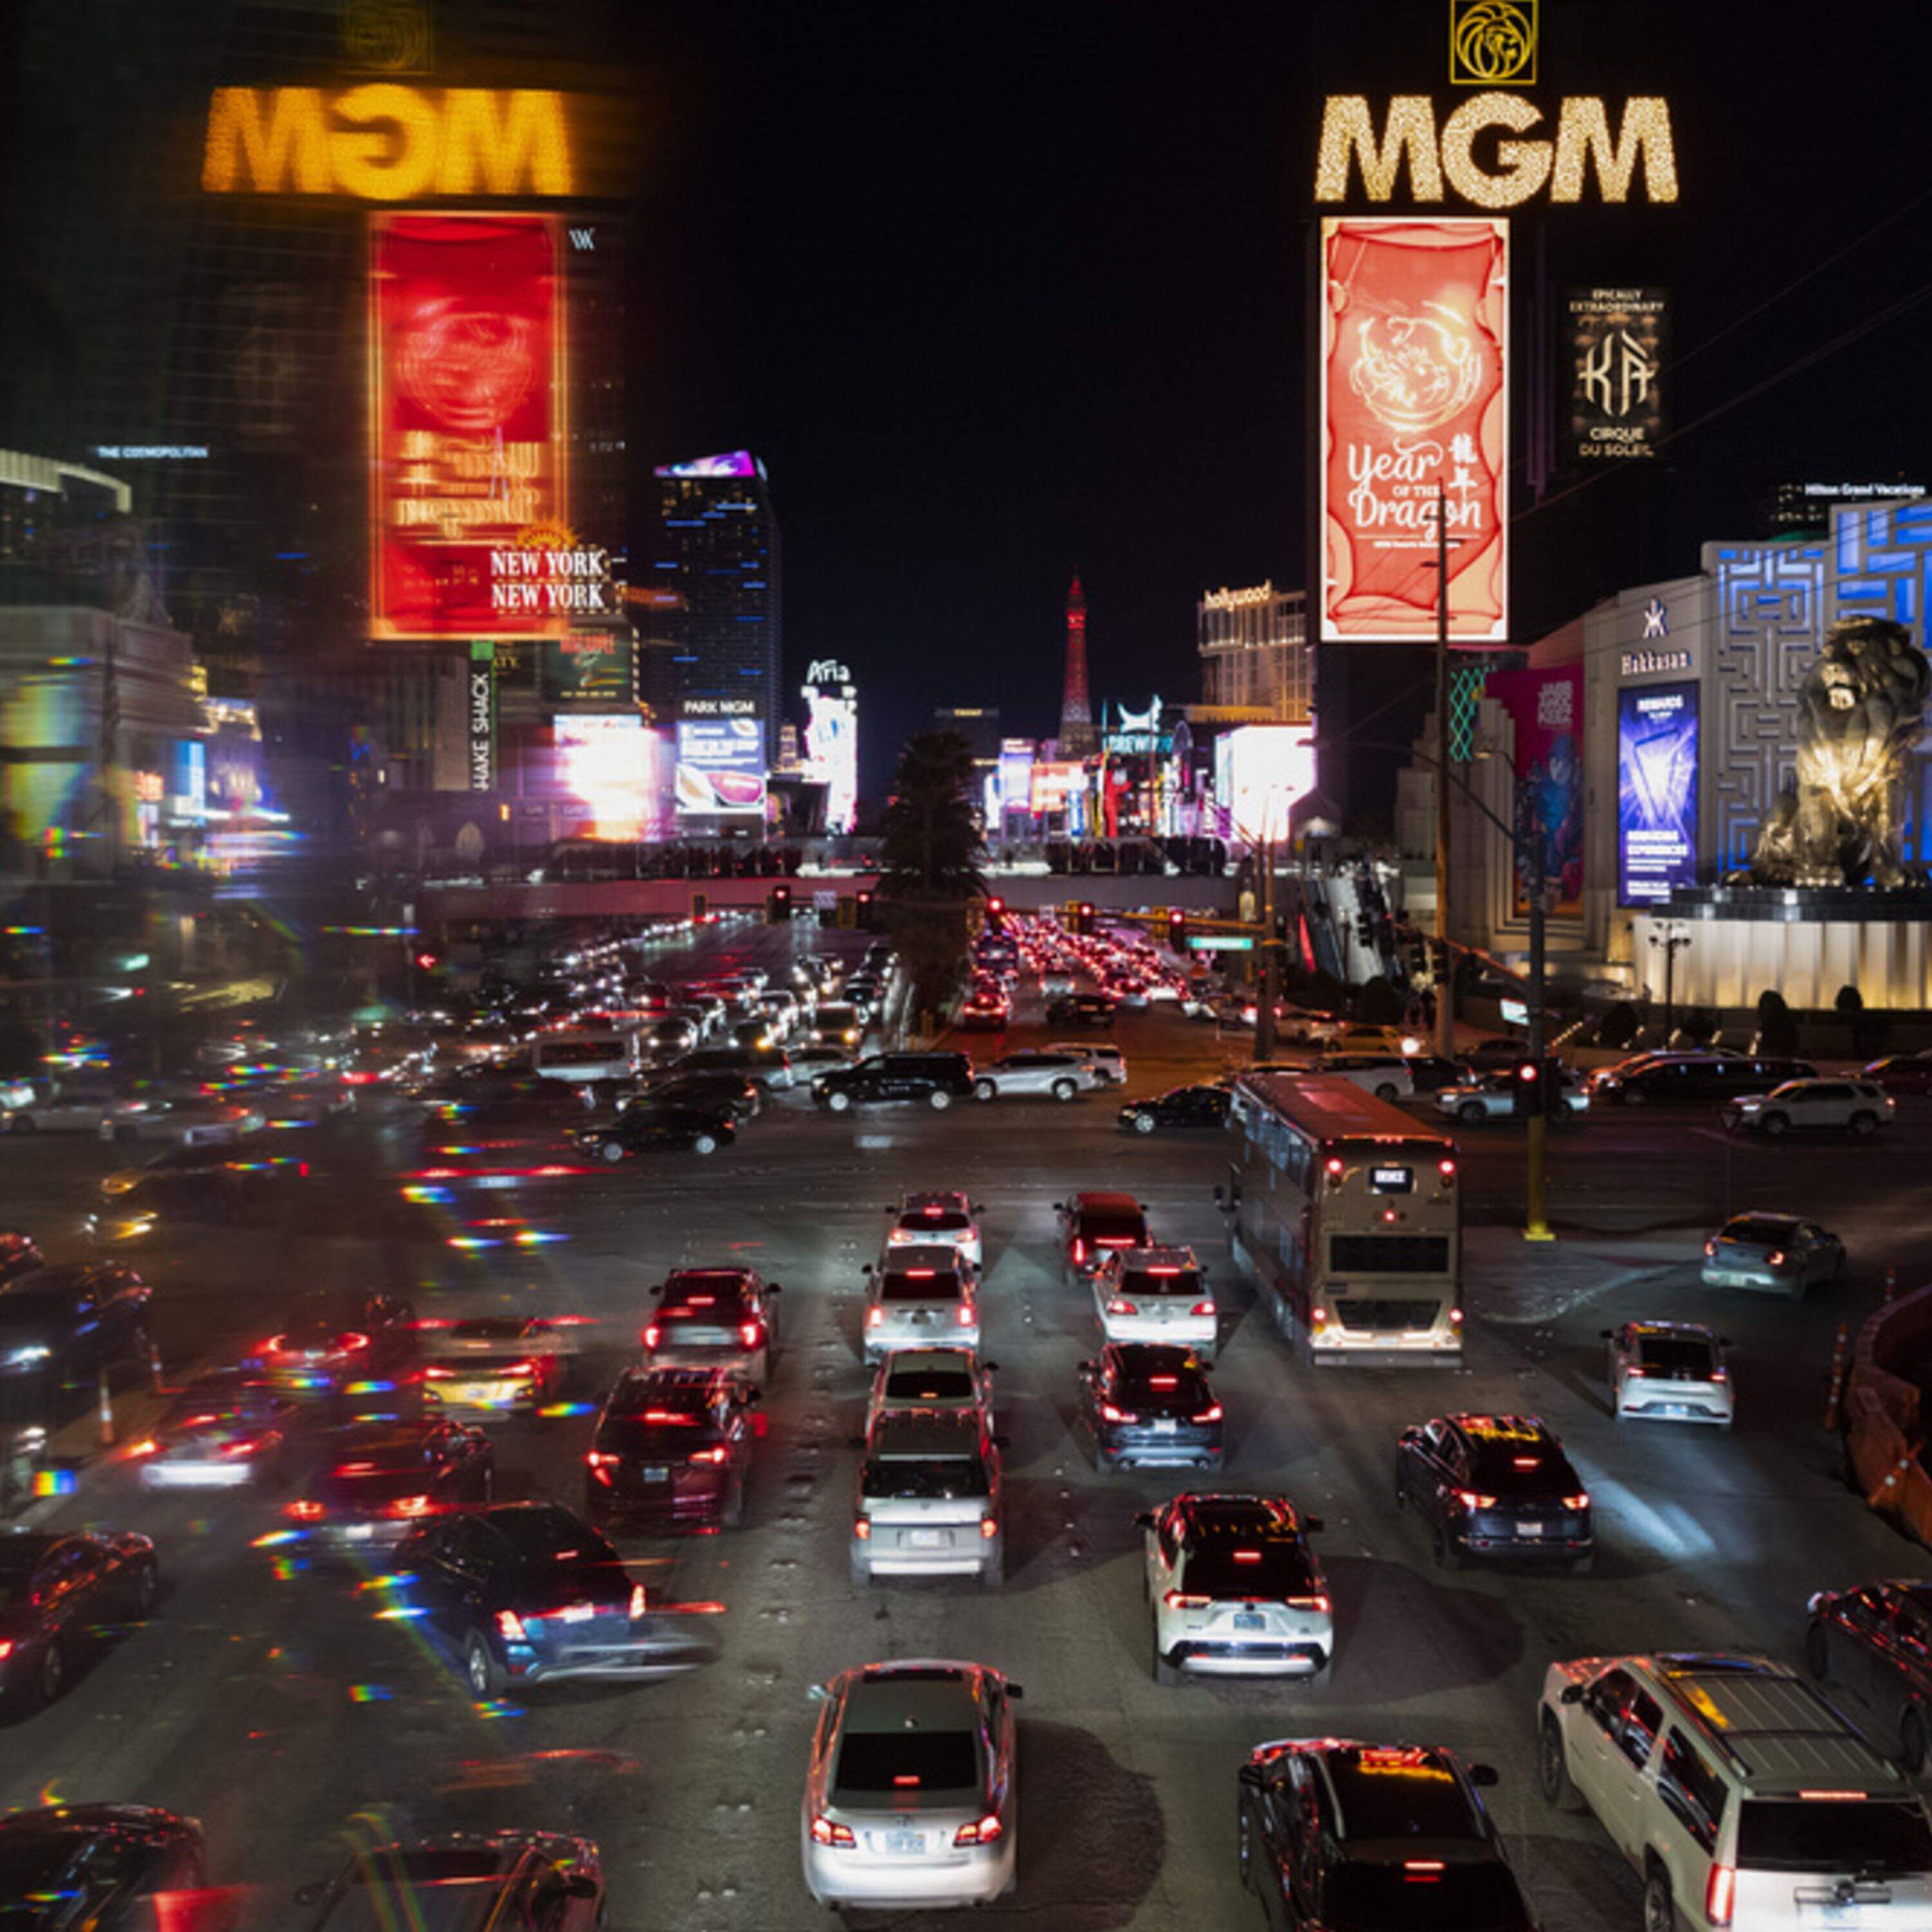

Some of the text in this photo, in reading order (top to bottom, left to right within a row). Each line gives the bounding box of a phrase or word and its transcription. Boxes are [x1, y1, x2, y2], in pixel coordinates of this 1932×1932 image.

[1314, 93, 1678, 207] MGM
[1589, 428, 1645, 443] CIRQUE
[1579, 444, 1601, 457] DU
[1348, 437, 1444, 495] Year
[1842, 483, 1873, 496] Grand
[1875, 483, 1926, 496] Vacations
[1348, 488, 1481, 542] Dragon
[491, 551, 604, 576] NEW YORK
[491, 583, 605, 608] NEW YORK
[1622, 650, 1687, 676] Hakkasan
[471, 673, 489, 734] SHACK
[683, 700, 717, 714] PARK
